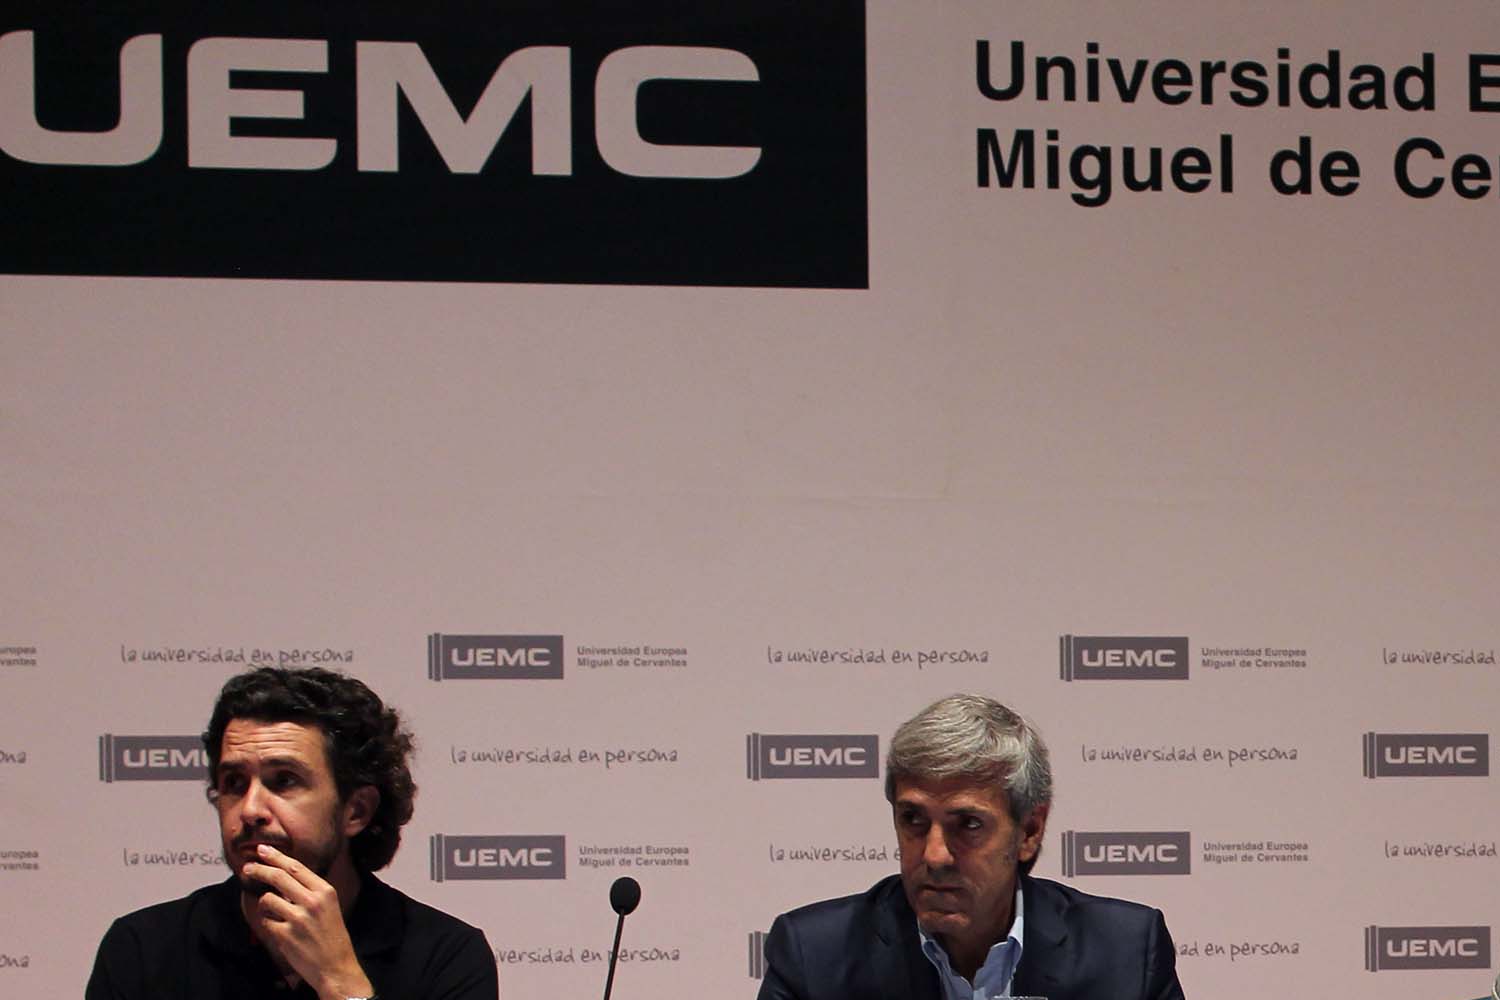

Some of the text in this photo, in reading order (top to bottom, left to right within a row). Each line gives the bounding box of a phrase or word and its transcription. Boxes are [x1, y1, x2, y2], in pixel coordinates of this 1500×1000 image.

[976, 40, 1435, 111] Universidad
[0, 30, 762, 179] UEMC
[977, 128, 1233, 207] Miguel
[1270, 136, 1360, 196] de
[121, 645, 353, 670] la universidad en persona
[452, 648, 550, 666] UEMC
[577, 646, 687, 658] Universidad Europea
[768, 646, 988, 670] la universidad en persona
[1082, 650, 1176, 667] UEMC
[1201, 648, 1306, 658] Universidad Europea
[1383, 648, 1397, 664] la
[1402, 650, 1496, 664] universidad
[577, 658, 687, 669] Miguel de Cervantes
[1202, 659, 1236, 669] Miguel
[1255, 659, 1306, 668] Cervantes
[123, 749, 207, 768] UEM
[451, 746, 677, 769] la universidad en persona
[770, 748, 865, 765] UEMC
[1082, 744, 1297, 767] la universidad en persona
[1385, 746, 1476, 764] UEMC
[579, 845, 689, 856] Universidad Europea
[770, 844, 784, 862] la
[790, 846, 888, 861] universidad
[1084, 844, 1177, 862] UEMC
[1204, 841, 1308, 852] Universidad Europea
[1385, 840, 1399, 858] la
[1404, 842, 1497, 858] universidad
[454, 848, 552, 866] UEMC
[579, 857, 689, 868] Miguel de Cervantes
[1204, 853, 1308, 864] Miguel de Cervantes
[1204, 943, 1225, 956] en
[1230, 942, 1299, 962] persona
[1387, 939, 1478, 957] UEMC
